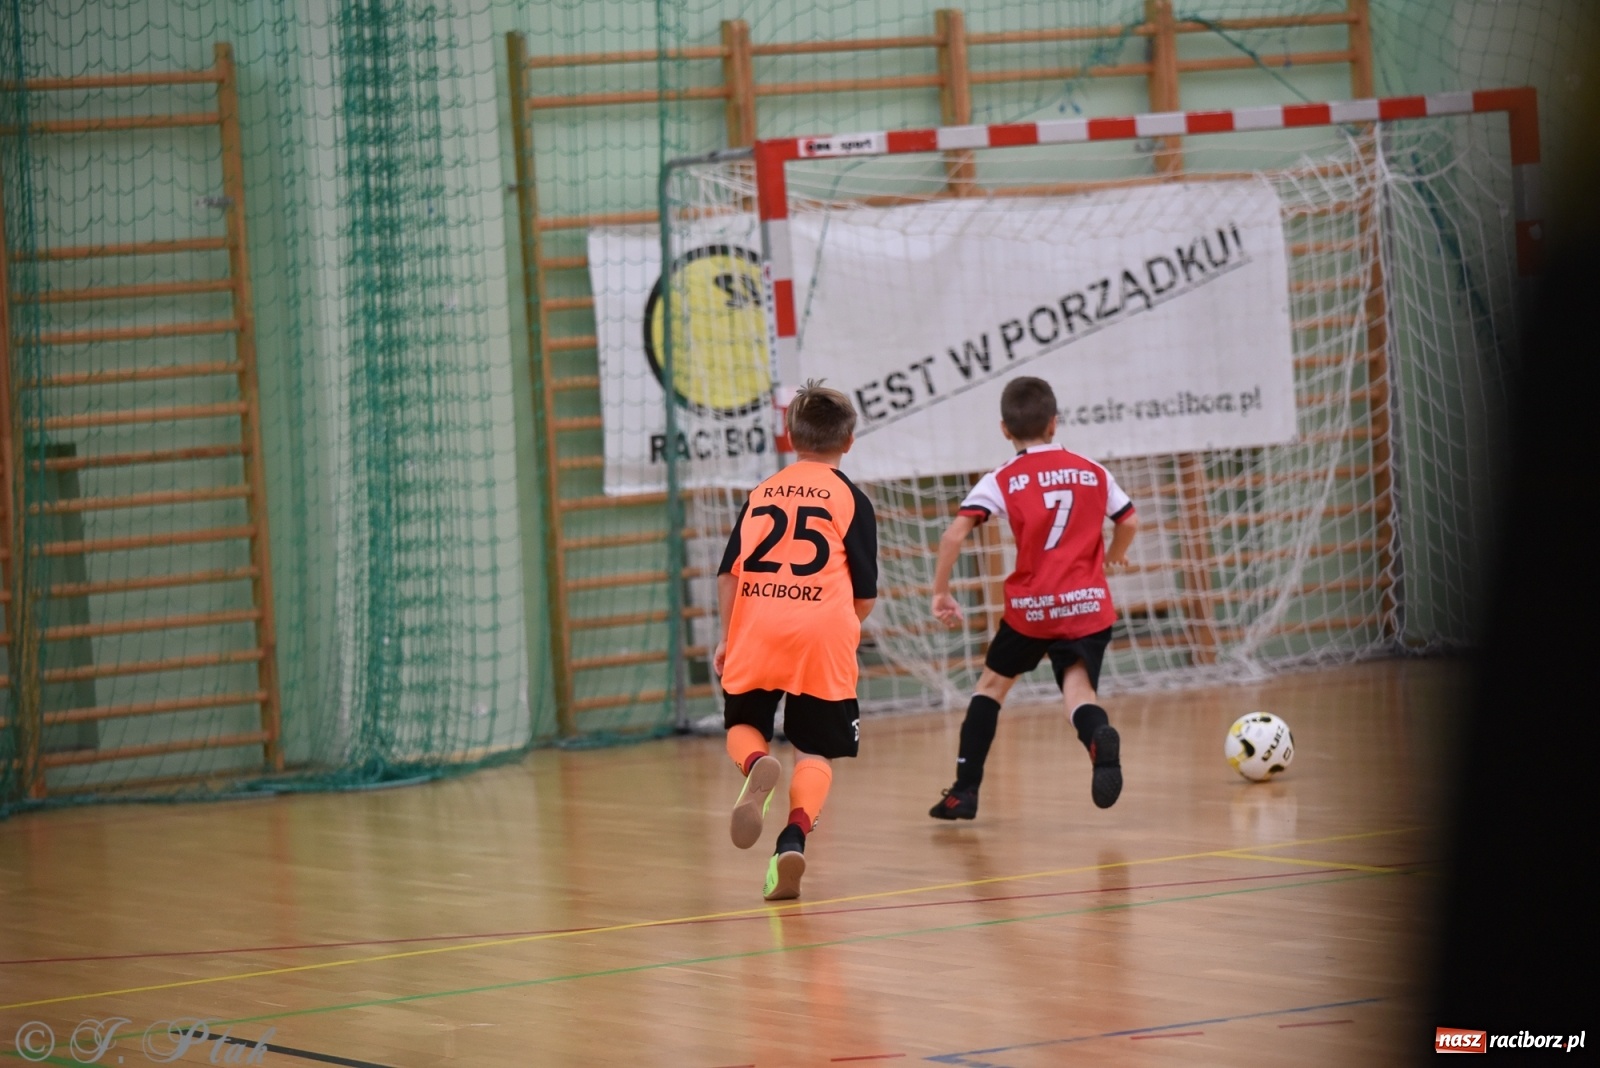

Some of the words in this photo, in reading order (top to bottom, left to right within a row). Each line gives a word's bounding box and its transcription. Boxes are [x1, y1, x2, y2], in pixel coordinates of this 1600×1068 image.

[855, 357, 936, 421] EST
[948, 333, 993, 381] W
[999, 222, 1246, 361] PORZĄDKU!
[650, 418, 767, 464] RACIBÓ
[763, 485, 831, 500] RAFAKO
[1008, 473, 1030, 495] AP
[1037, 468, 1099, 487] UNITED
[1042, 489, 1074, 551] 7
[743, 504, 833, 577] 25
[741, 582, 823, 602] RACIBÓRZ
[1049, 600, 1101, 619] WIELKIEGO
